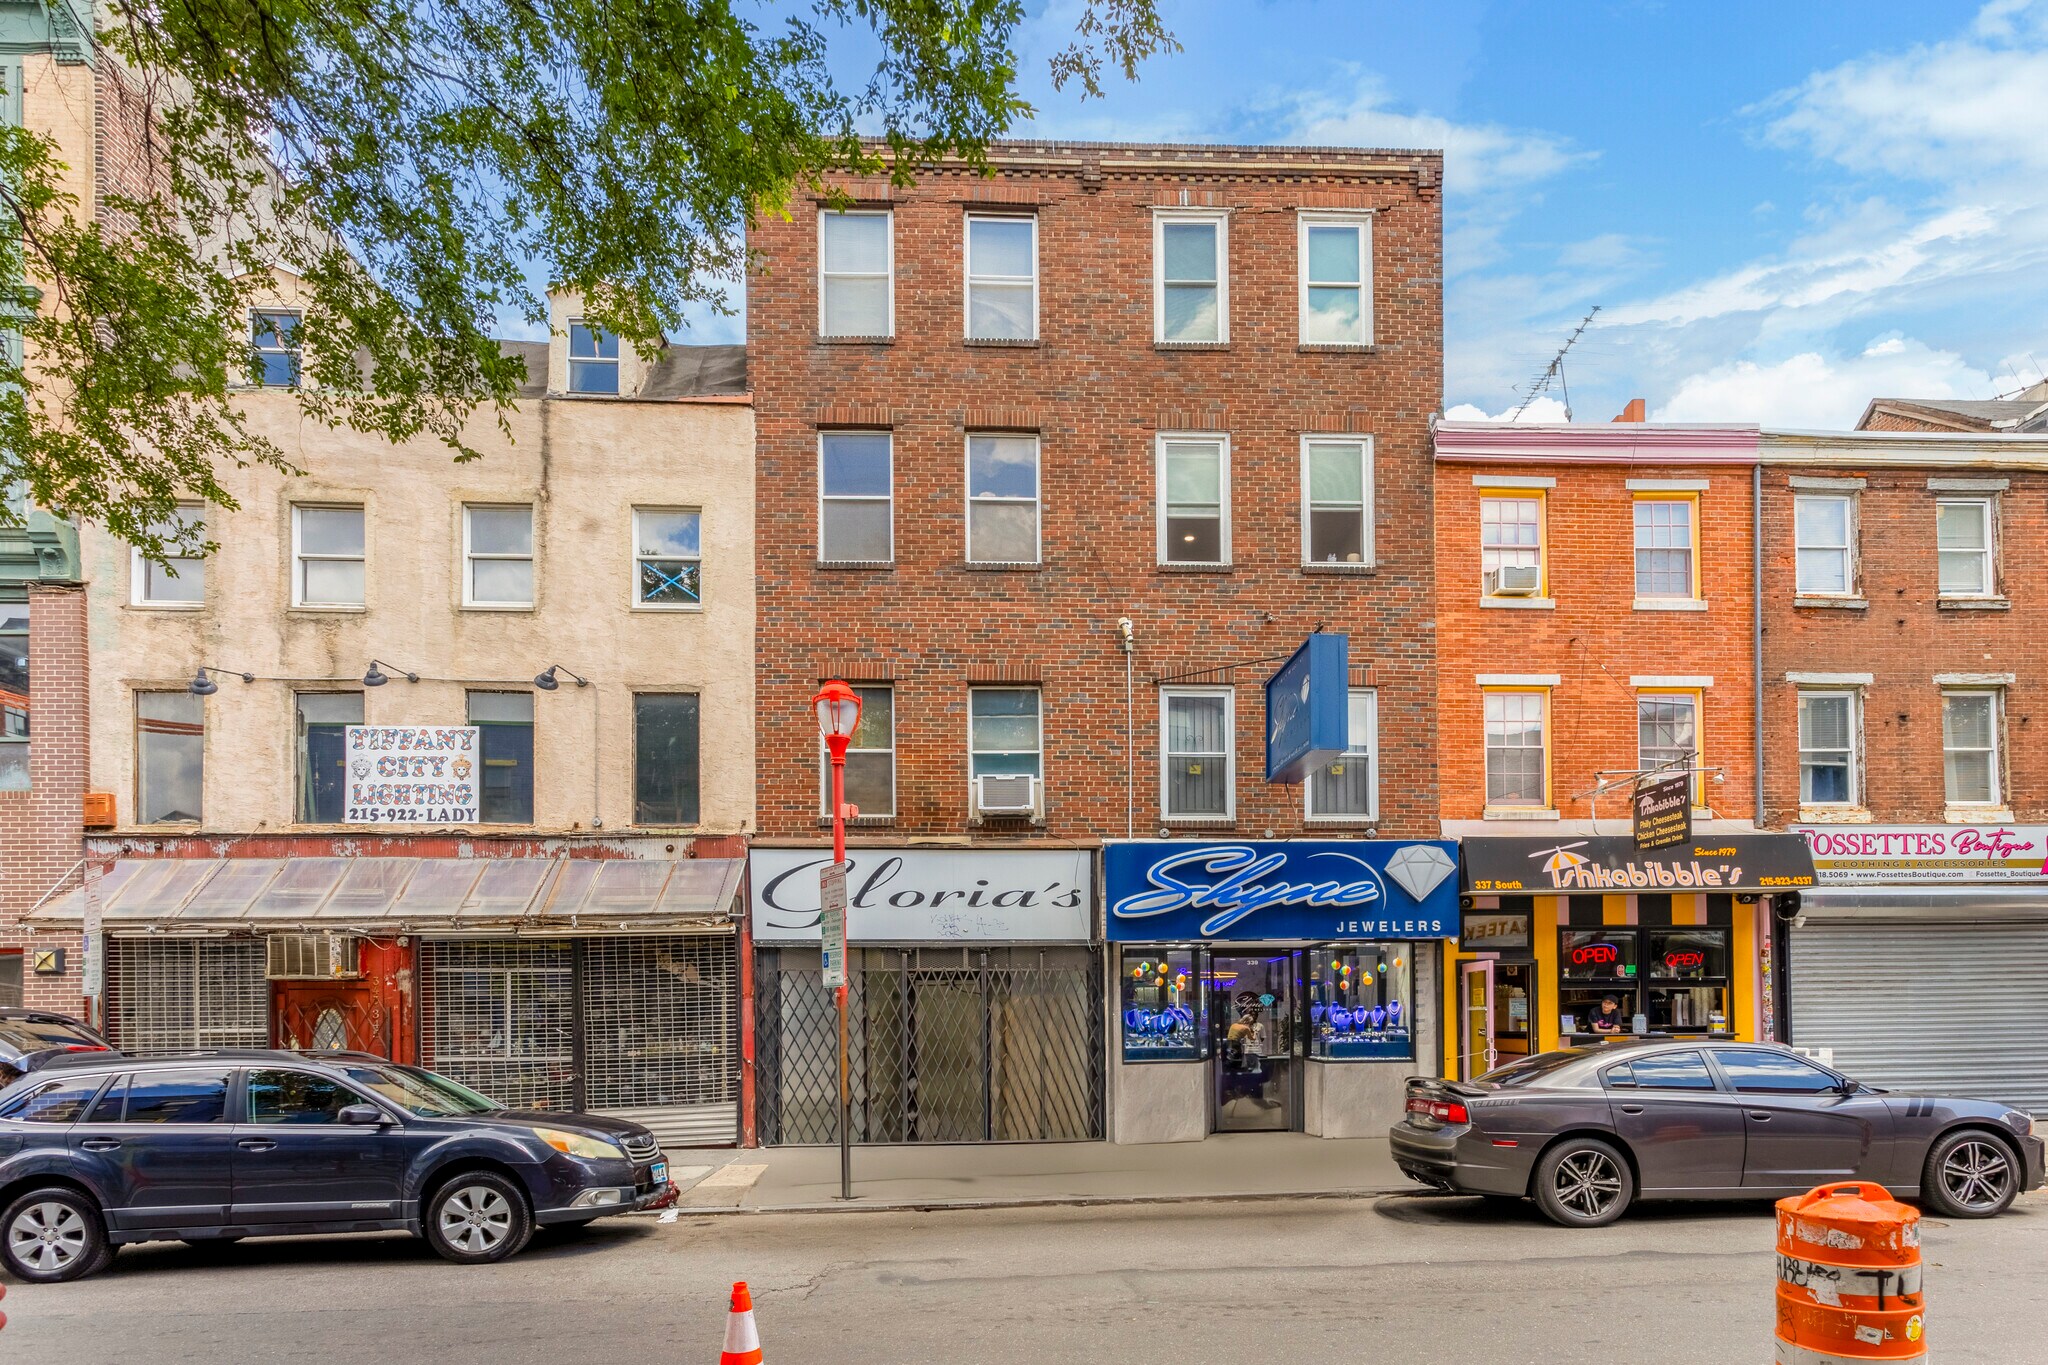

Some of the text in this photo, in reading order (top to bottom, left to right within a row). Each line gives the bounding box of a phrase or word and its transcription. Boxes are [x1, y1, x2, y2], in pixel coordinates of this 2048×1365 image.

[350, 728, 477, 750] TIFFANY
[376, 755, 449, 778] CITY
[352, 783, 474, 806] LIGHTING
[1663, 784, 1674, 792] Since
[349, 807, 477, 822] 215-922-LADY
[1640, 810, 1683, 829] Philly Cheesesteak
[1637, 821, 1687, 841] Chicken Cheesesteak
[1672, 833, 1683, 842] Drink
[1951, 828, 2035, 860] Boutique
[1833, 860, 2007, 868] CLOTHING & ACCESSORIES
[1759, 876, 1812, 886] 215-923-4337
[1856, 871, 1964, 879] www.FossettesBoutique.com
[1975, 870, 2040, 878] Fossettes_Boutique
[1113, 846, 1379, 937] Shyne
[1475, 880, 1522, 889] 337 South
[762, 857, 1082, 929] Gloria's
[1336, 920, 1442, 933] JEWELERS
[1572, 947, 1616, 964] OPEN
[1665, 952, 1704, 967] OPEN
